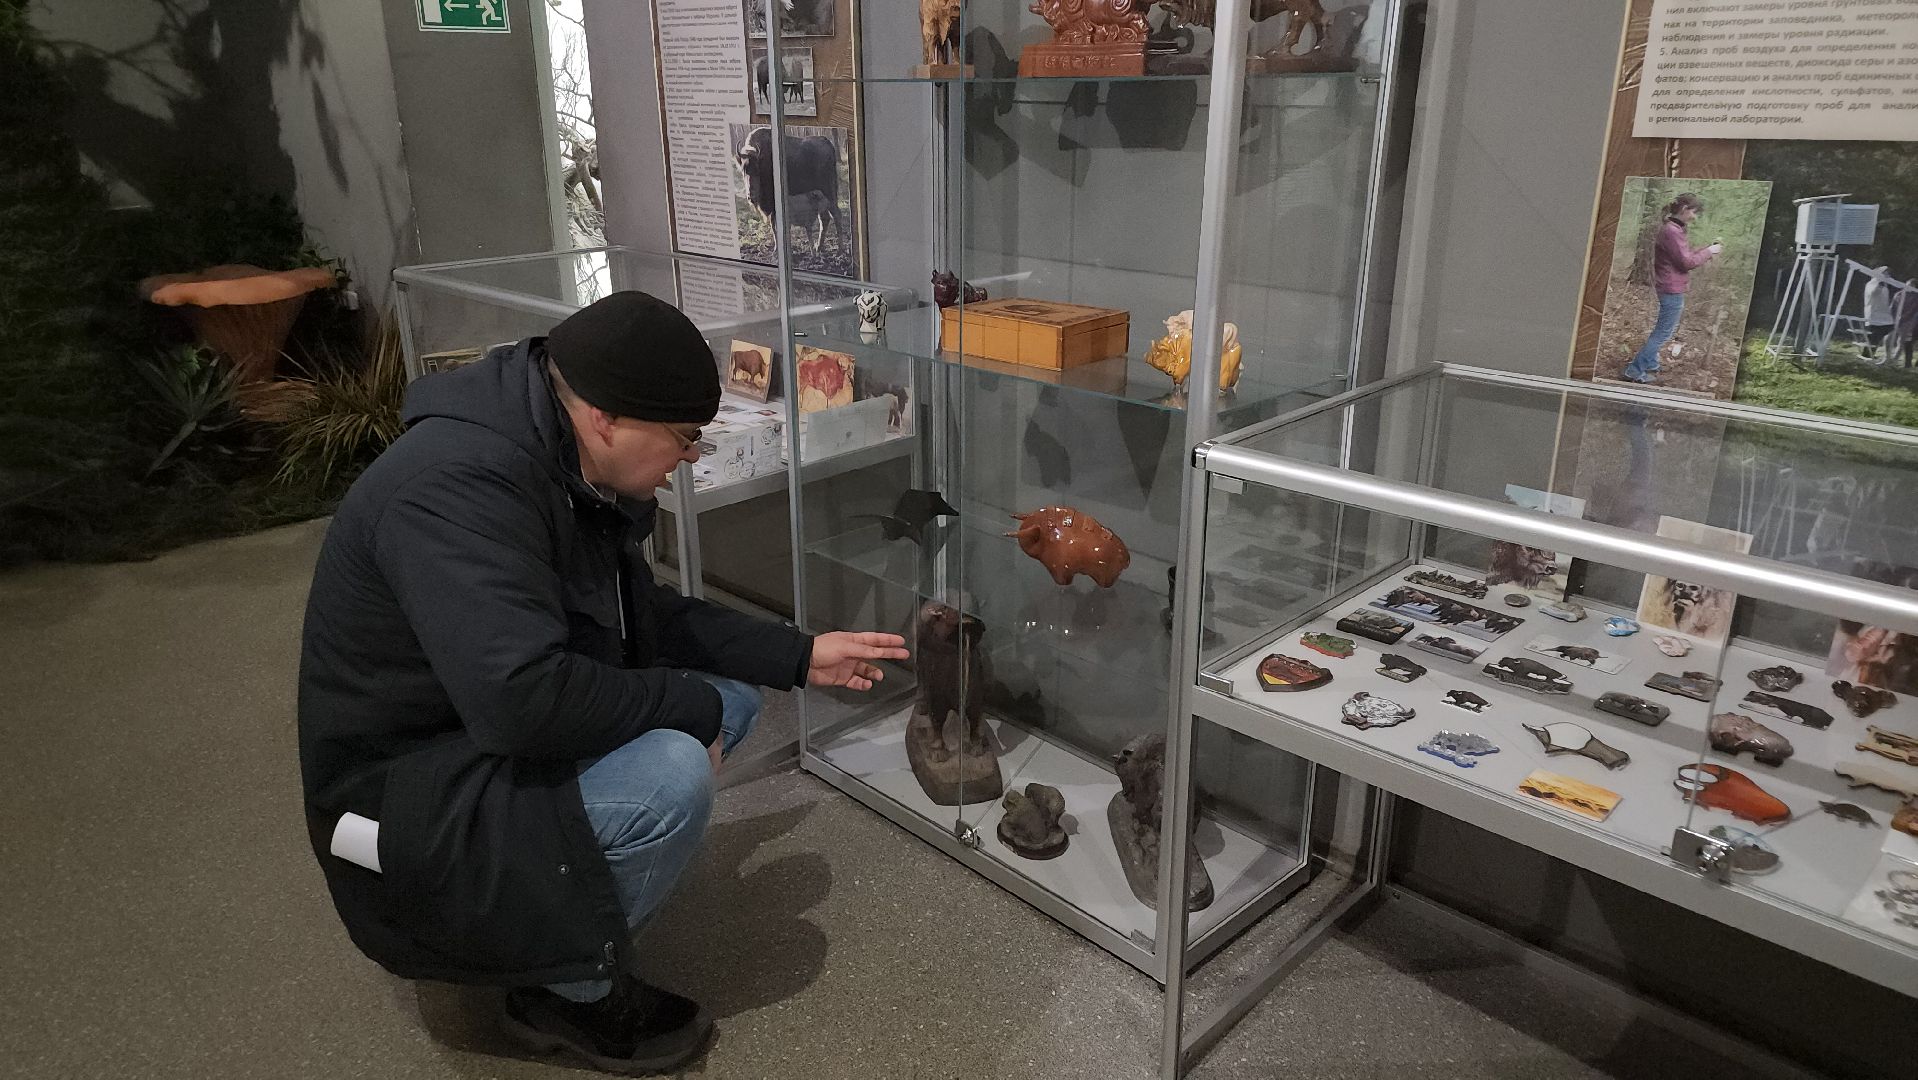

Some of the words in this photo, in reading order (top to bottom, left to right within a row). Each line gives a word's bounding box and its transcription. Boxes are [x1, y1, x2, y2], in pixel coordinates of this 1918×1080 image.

[1686, 5, 1740, 14] включают
[1742, 3, 1786, 12] замеры
[1789, 2, 1828, 11] уровня
[1685, 20, 1696, 28] на
[1702, 17, 1763, 28] территории
[1768, 14, 1845, 25] заповедника,
[1856, 13, 1918, 21] метеорол
[1662, 33, 1725, 43] наблюдения
[1737, 31, 1781, 41] замеры
[1783, 30, 1823, 40] уровня
[1826, 29, 1889, 37] радиации.
[1671, 47, 1708, 55] Анализ
[1712, 45, 1738, 55] проб
[1743, 45, 1786, 55] воздуха
[1790, 45, 1812, 54] для
[1816, 42, 1896, 53] определения
[1657, 62, 1676, 70] ции
[1679, 60, 1743, 69] взвешенных
[1746, 59, 1793, 69] веществ,
[1796, 58, 1852, 69] диоксида
[1856, 58, 1884, 68] серы
[1689, 75, 1760, 83] консервацию
[1772, 73, 1811, 82] анализ
[1813, 72, 1841, 83] проб
[1844, 73, 1912, 82] единичных
[1652, 88, 1671, 96] для
[1676, 88, 1745, 97] определения
[1752, 87, 1823, 96] кислотности,
[1831, 87, 1894, 97] сульфатов,
[1650, 102, 1742, 110] предварительную
[1747, 102, 1808, 111] подготовку
[1815, 100, 1843, 110] проб
[1848, 103, 1871, 112] для
[1656, 114, 1727, 124] региональной
[1730, 115, 1803, 125] лаборатории.
